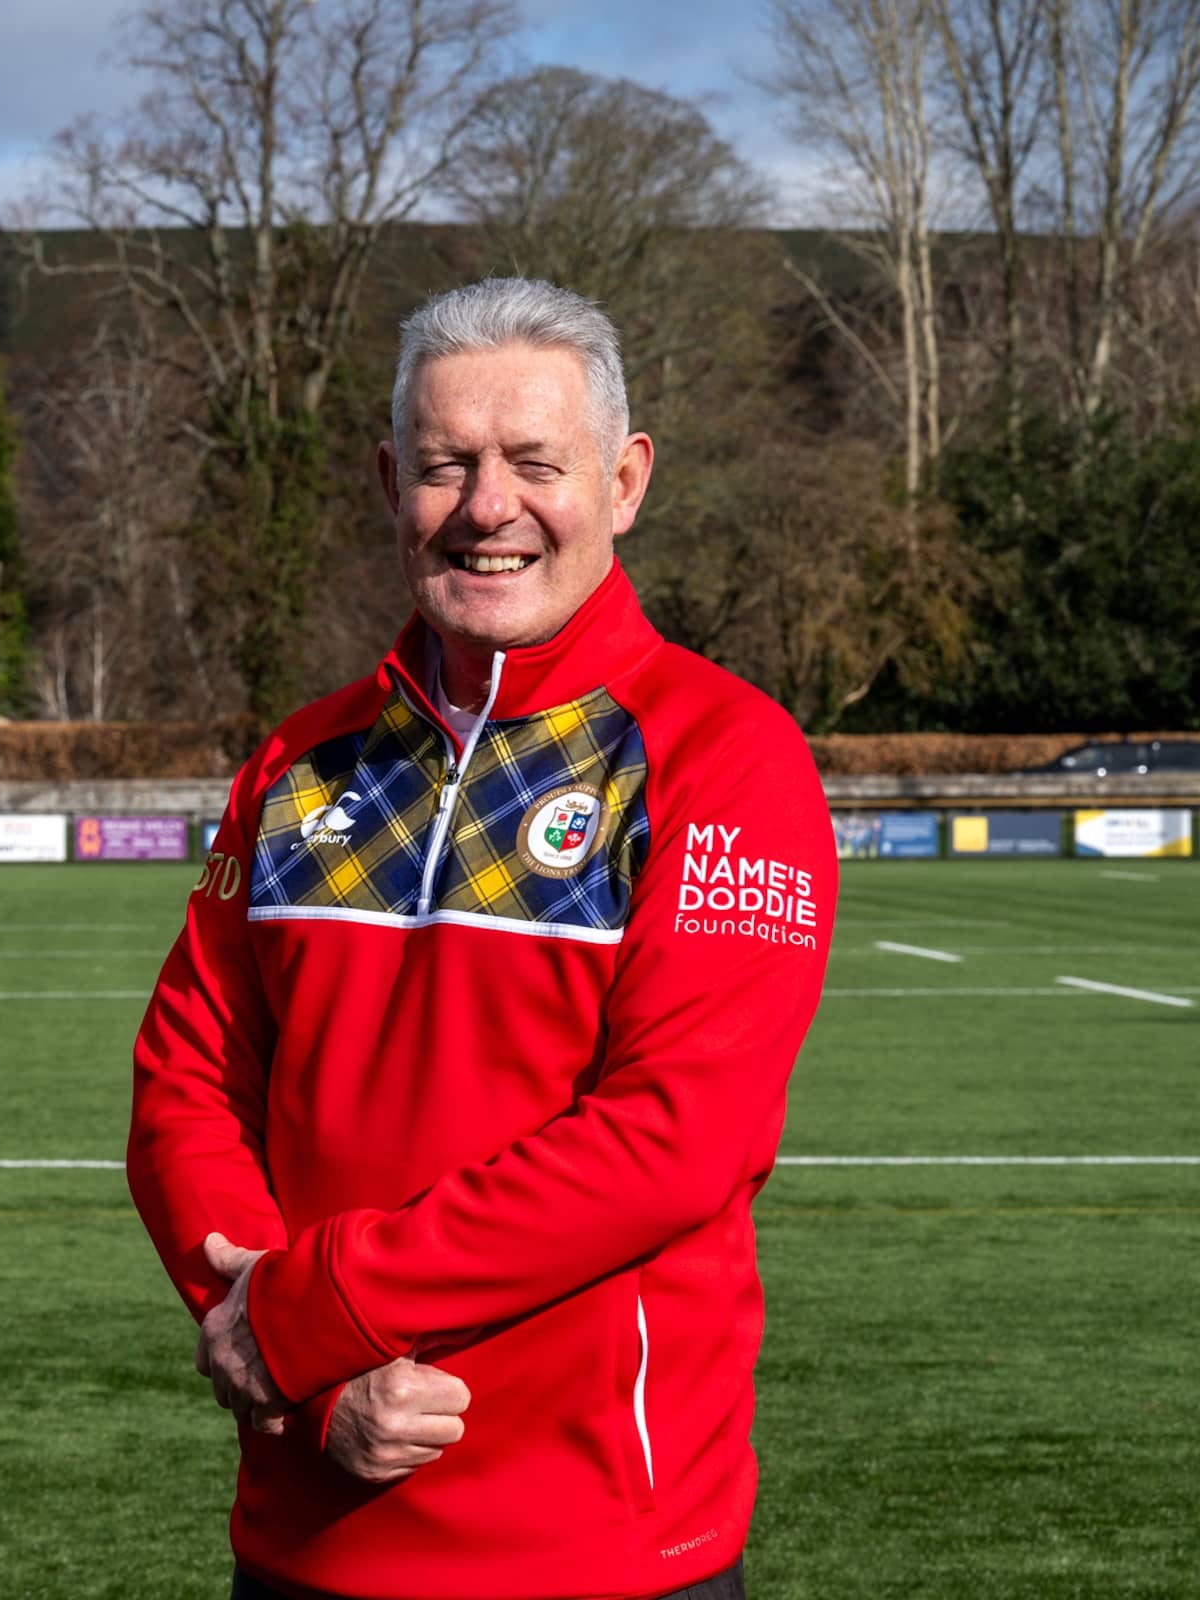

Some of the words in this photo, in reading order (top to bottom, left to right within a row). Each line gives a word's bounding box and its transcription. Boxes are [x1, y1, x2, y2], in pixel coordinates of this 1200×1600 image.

[686, 823, 741, 853] MY
[535, 863, 561, 876] LIONS
[678, 884, 816, 927] DODDIE
[674, 913, 816, 950] foundation
